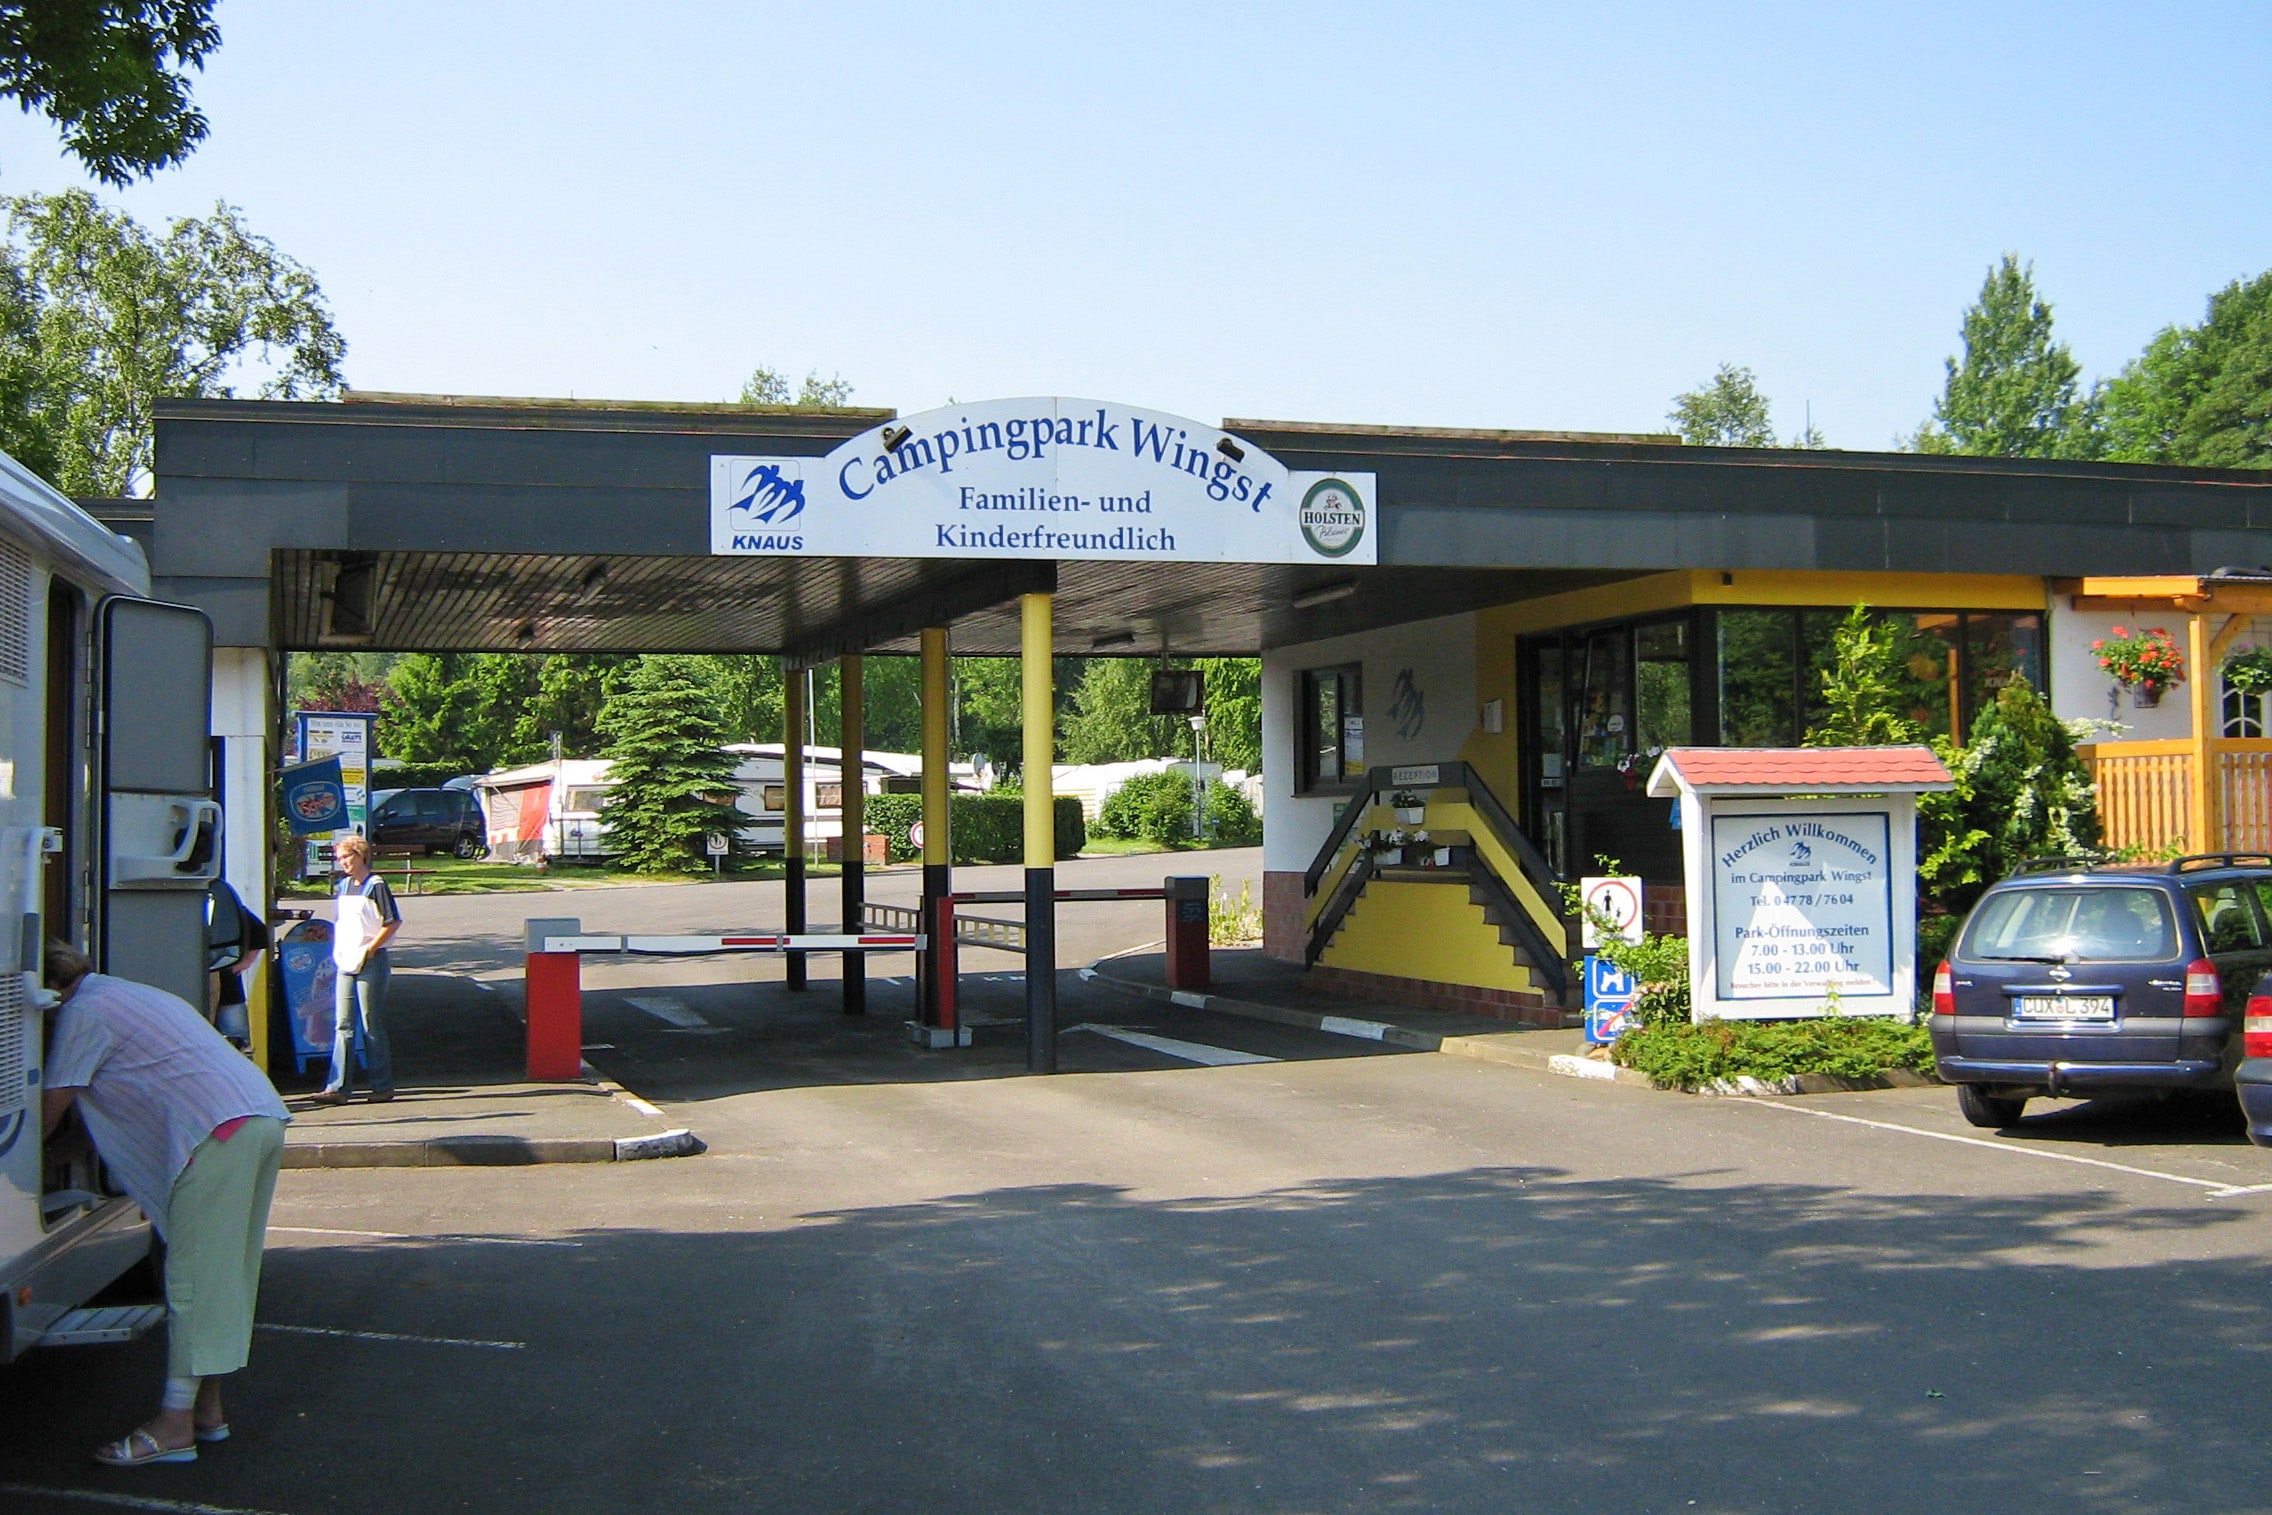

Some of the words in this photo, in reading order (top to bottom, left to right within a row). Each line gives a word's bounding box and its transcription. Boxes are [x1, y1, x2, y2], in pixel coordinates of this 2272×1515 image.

[839, 408, 1120, 500] Campingpark
[1131, 417, 1273, 512] Wingst
[959, 486, 1091, 512] Familien-
[1098, 490, 1152, 513] und
[1303, 511, 1361, 525] HOLSTEN
[732, 535, 804, 550] KNAUS
[935, 523, 1176, 551] Kinderfreundlich
[1721, 827, 1781, 867] Herzlich
[1785, 823, 1877, 865] Willkommen
[1731, 873, 1746, 883] im
[1749, 870, 1826, 885] Campingpark
[1831, 871, 1872, 884] Wingst
[1750, 895, 1770, 906] Tel.
[1735, 923, 1870, 940] Park-Öffnungszeiten
[1751, 944, 1779, 956] 7.00
[1792, 943, 1826, 956] 13.00
[1830, 942, 1855, 955] Uhr
[1748, 962, 1782, 975] 15.00
[1794, 961, 1831, 974] 22.00
[1835, 960, 1860, 972] Uhr
[2023, 997, 2053, 1014] CUX
[2065, 997, 2076, 1014] L
[2080, 997, 2110, 1015] 394
